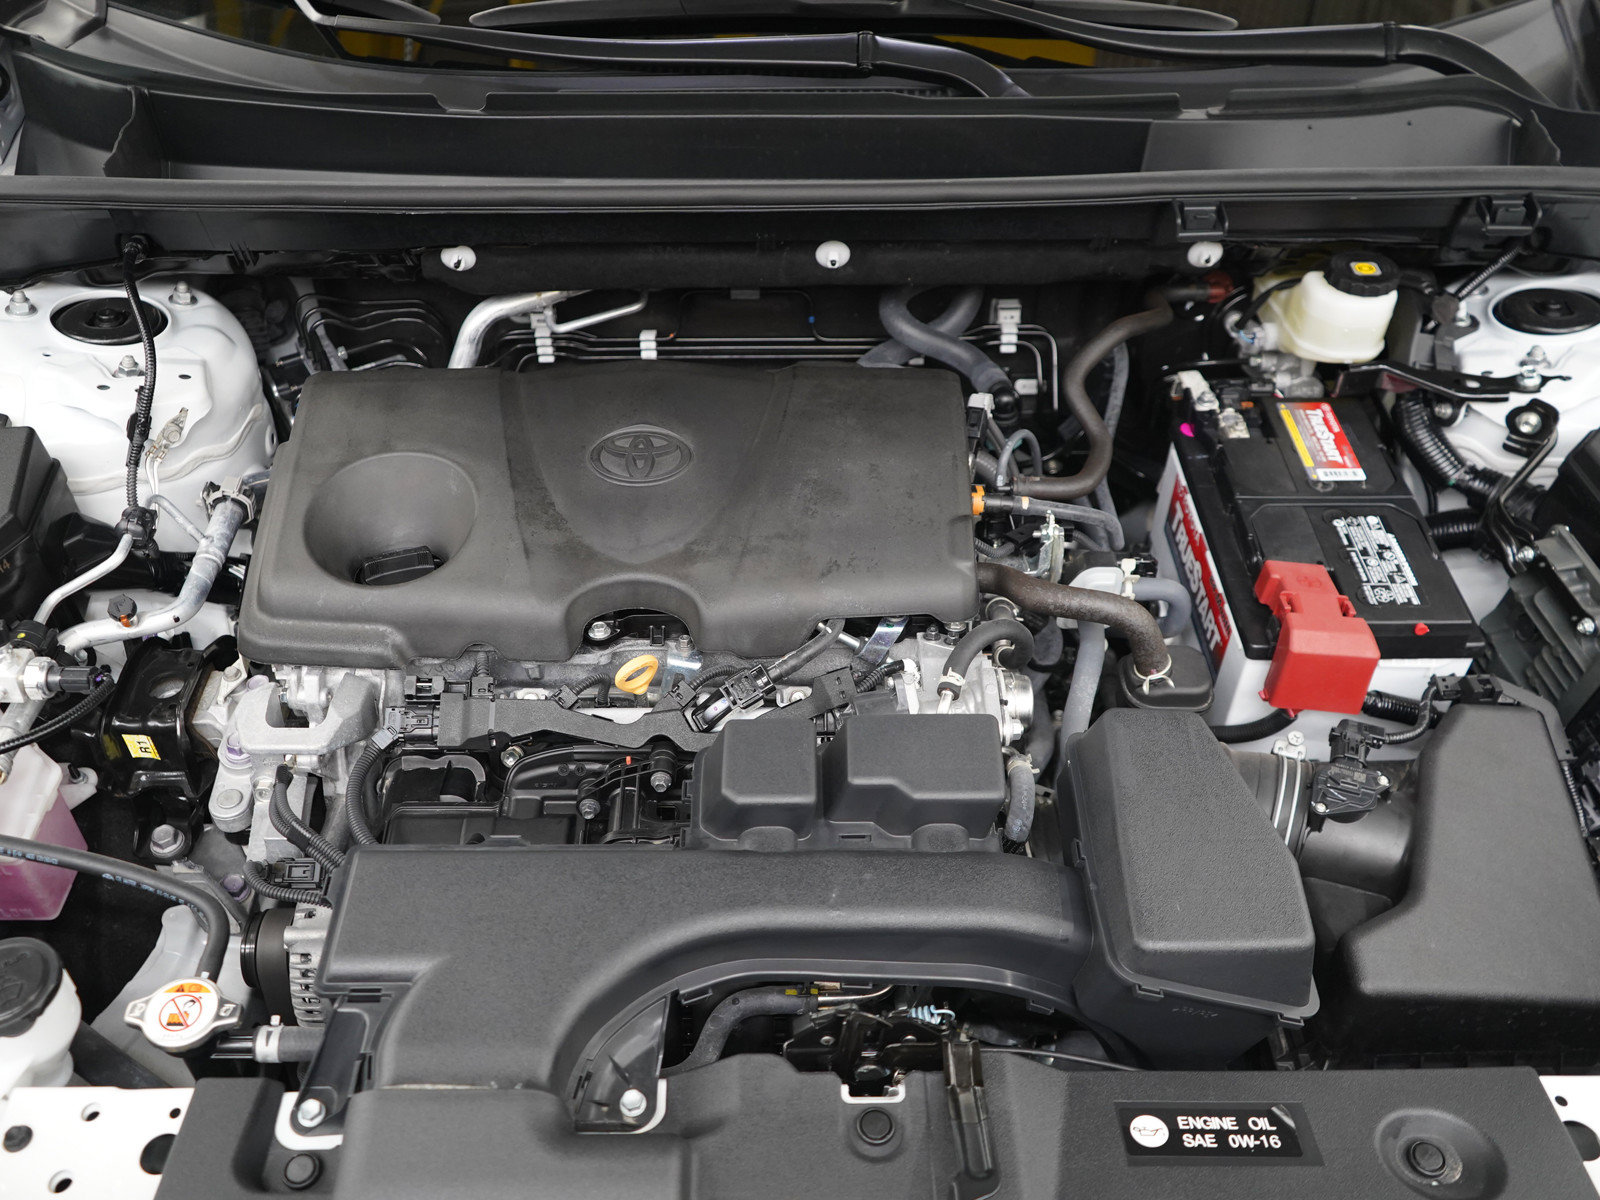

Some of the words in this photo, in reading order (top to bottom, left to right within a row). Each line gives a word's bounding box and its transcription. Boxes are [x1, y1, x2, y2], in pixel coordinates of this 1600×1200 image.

[136, 740, 152, 754] R1
[1176, 1115, 1239, 1130] ENGINE
[1248, 1116, 1278, 1131] OIL
[1182, 1133, 1218, 1148] SAE
[1228, 1134, 1282, 1149] 0W-16
